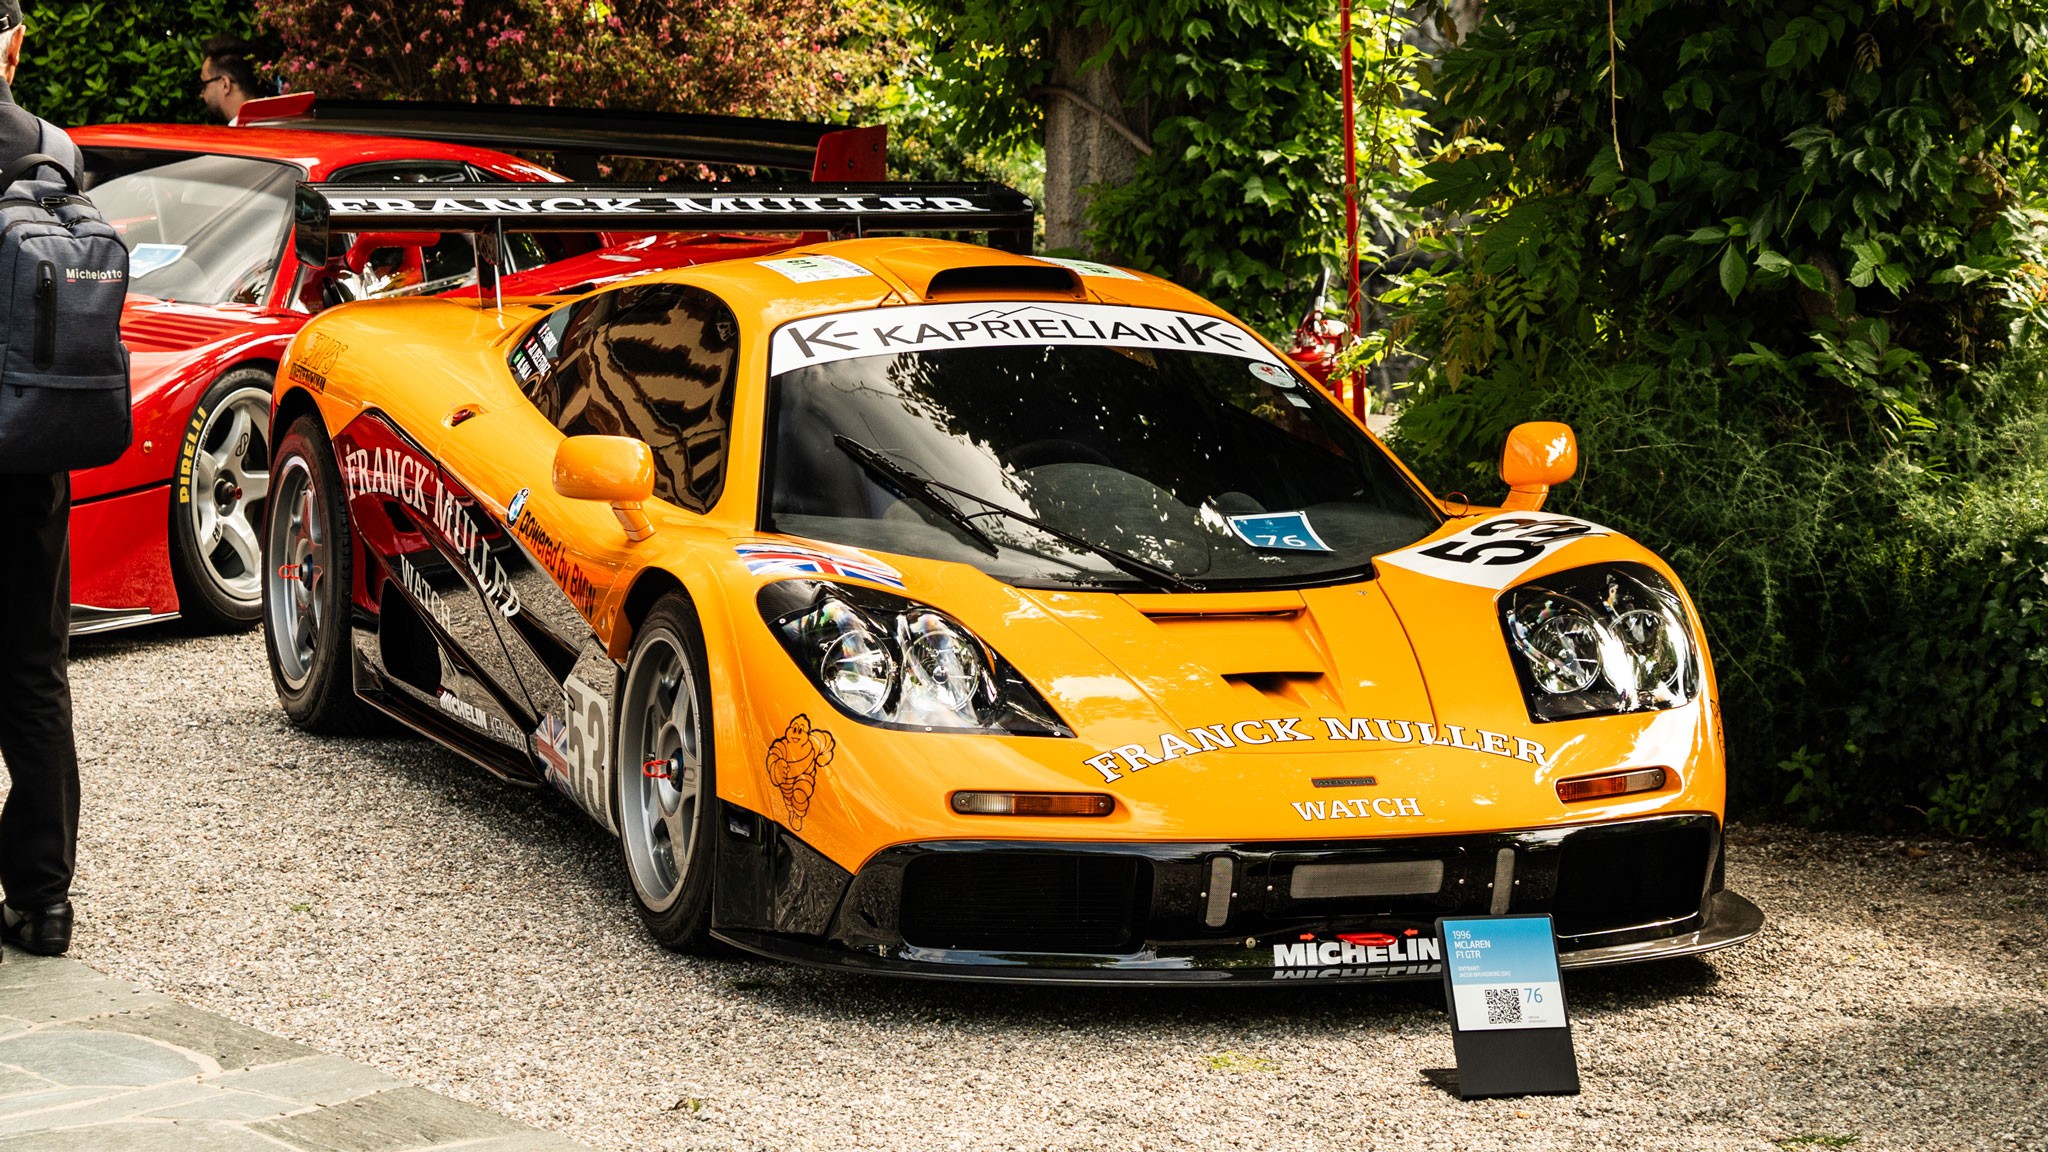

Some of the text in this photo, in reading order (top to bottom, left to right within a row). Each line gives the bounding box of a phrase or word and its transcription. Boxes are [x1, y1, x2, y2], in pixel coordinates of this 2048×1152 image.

[327, 197, 991, 213] FRANCK MULLER
[66, 268, 122, 280] Michelotto
[872, 319, 1187, 347] KAPRIELIAN
[180, 406, 208, 504] PIRELLI
[345, 447, 521, 622] FRANCK MULLER
[1255, 534, 1308, 547] 76
[517, 509, 562, 572] powered
[557, 547, 571, 592] by
[569, 562, 596, 619] BMW
[400, 553, 453, 637] WATCH
[440, 691, 488, 730] MICHELIN
[566, 684, 609, 830] 53
[1083, 717, 1551, 784] FRANCK MULLER
[1291, 797, 1425, 822] WATCH
[1452, 930, 1472, 940] 1996
[1454, 940, 1491, 949] MCLAREN
[1272, 937, 1441, 967] MICHELIN
[1456, 950, 1482, 959] F1 GTR
[1523, 988, 1543, 1003] 76
